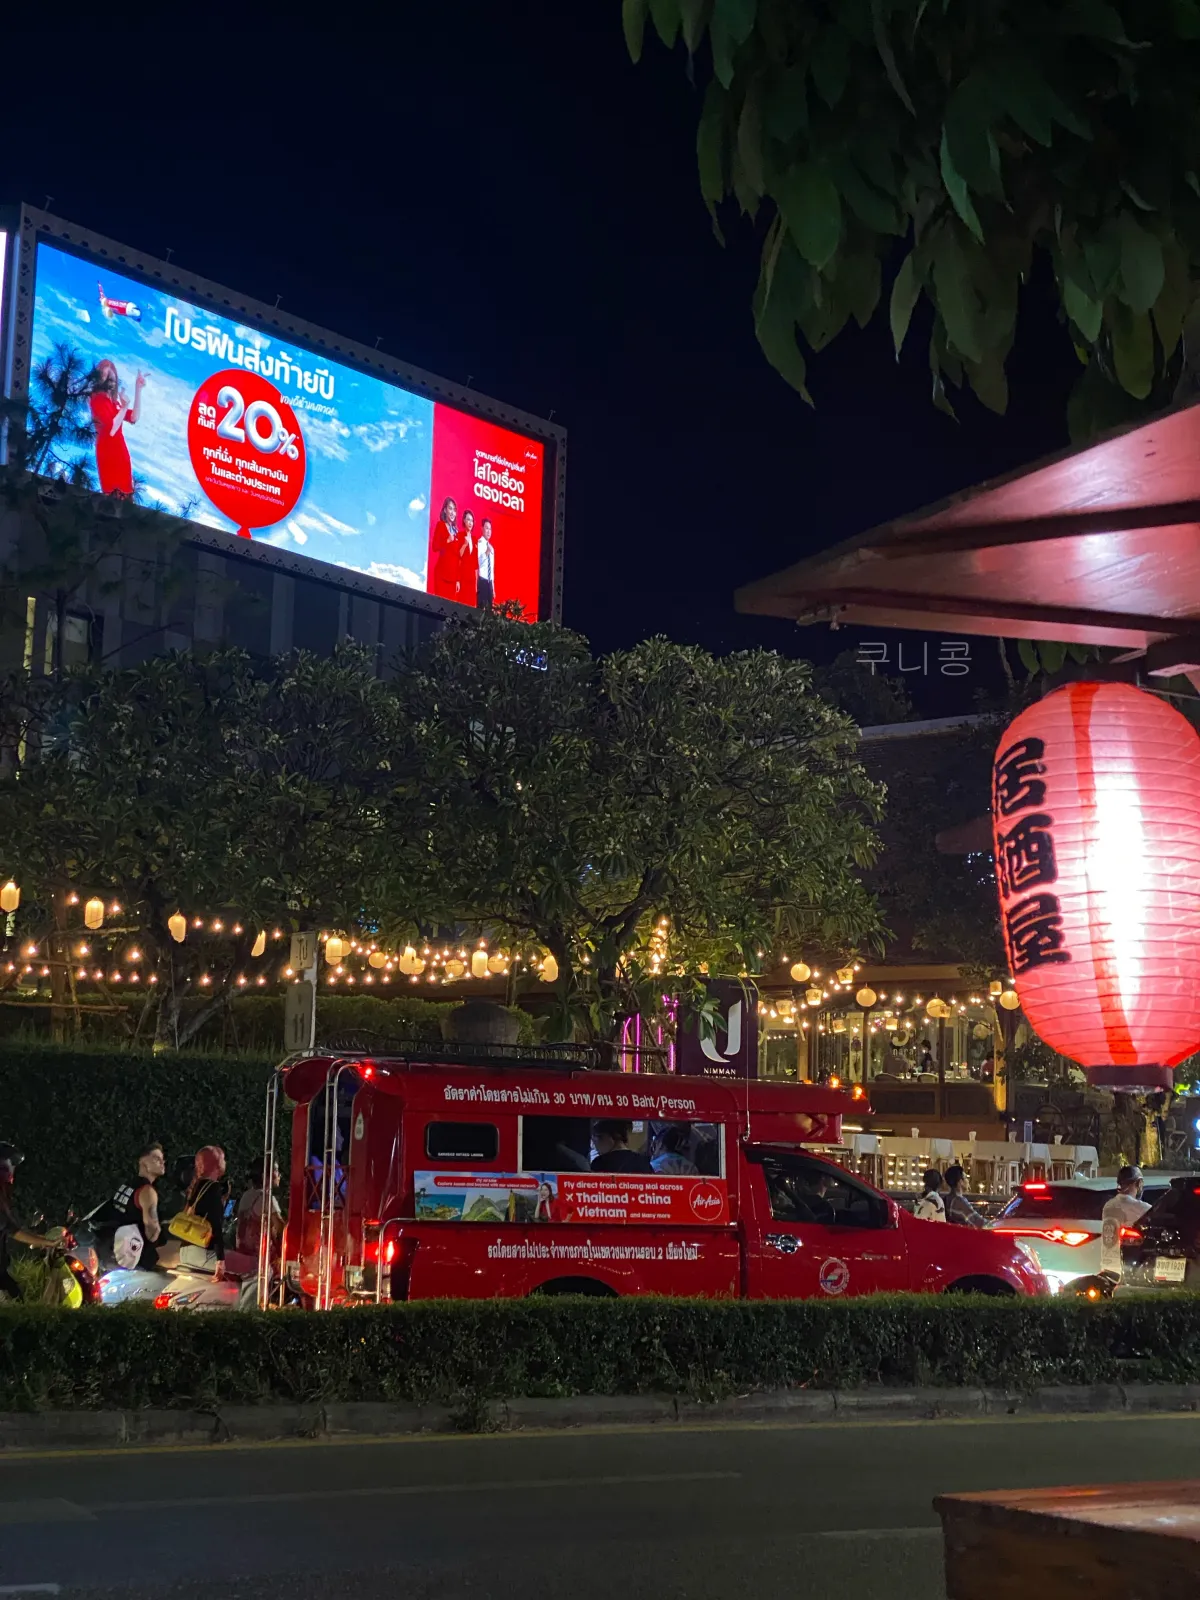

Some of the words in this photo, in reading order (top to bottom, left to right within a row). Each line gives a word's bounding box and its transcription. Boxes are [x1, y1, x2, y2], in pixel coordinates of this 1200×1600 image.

[165, 306, 335, 400] โปรฟินส่งท้ายปี
[198, 402, 216, 418] ลด
[197, 415, 216, 430] ทันที
[203, 446, 233, 463] ทุกที่นั่ง
[235, 458, 288, 483] ทุกเส้นทางบิน
[211, 461, 280, 495] ในและต่างประเทศ
[473, 458, 524, 494] ใส่ใจเรื่อง
[473, 482, 524, 513] ตรงเวลา
[993, 735, 1070, 973] 居酒屋
[703, 1067, 736, 1075] NIMMAN
[444, 1084, 550, 1104] อัตราค่าโดยสารไม่เกิน
[553, 1092, 565, 1104] 30
[617, 1094, 628, 1106] 30
[564, 1181, 574, 1190] Fly
[577, 1181, 598, 1189] direct
[599, 1181, 617, 1189] from
[618, 1182, 644, 1191] Chiang
[576, 1192, 628, 1204] Thailand
[638, 1192, 671, 1205] China
[577, 1205, 626, 1218] Vietnam
[657, 1247, 663, 1260] 2
[665, 1240, 698, 1261] เชียงใหม่
